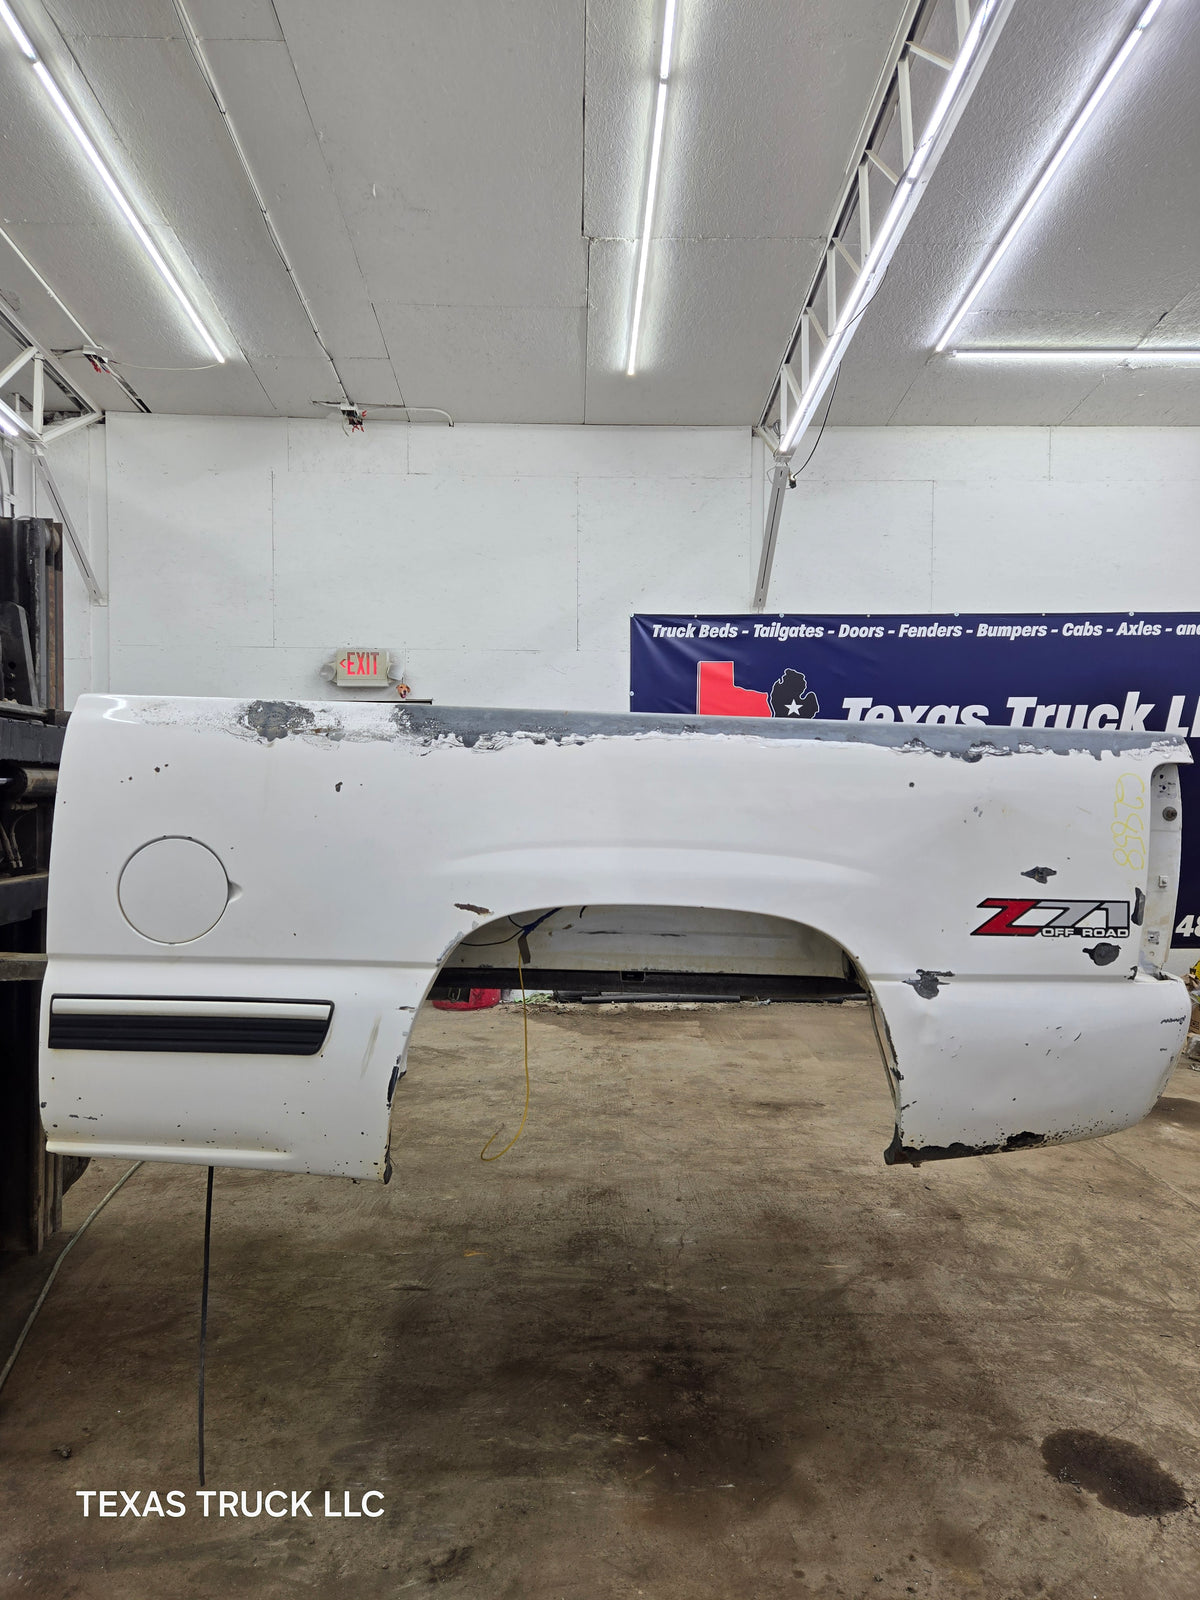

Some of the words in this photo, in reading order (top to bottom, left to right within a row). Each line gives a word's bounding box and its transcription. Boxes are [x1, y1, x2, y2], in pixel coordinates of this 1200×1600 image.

[652, 622, 696, 638] Truck
[698, 622, 738, 638] Beds
[753, 622, 824, 642] Tailgates
[837, 623, 885, 638] Doors
[898, 622, 963, 638] Fenders
[976, 623, 1048, 641] Bumpers
[1062, 622, 1103, 636] Cabs
[1116, 621, 1162, 636] Axles
[346, 651, 380, 676] EXIT
[842, 697, 990, 727] Texas
[1006, 691, 1155, 732] Truck
[970, 898, 1131, 937] Z71
[1041, 926, 1075, 937] OFF
[1081, 927, 1130, 938] ROAD
